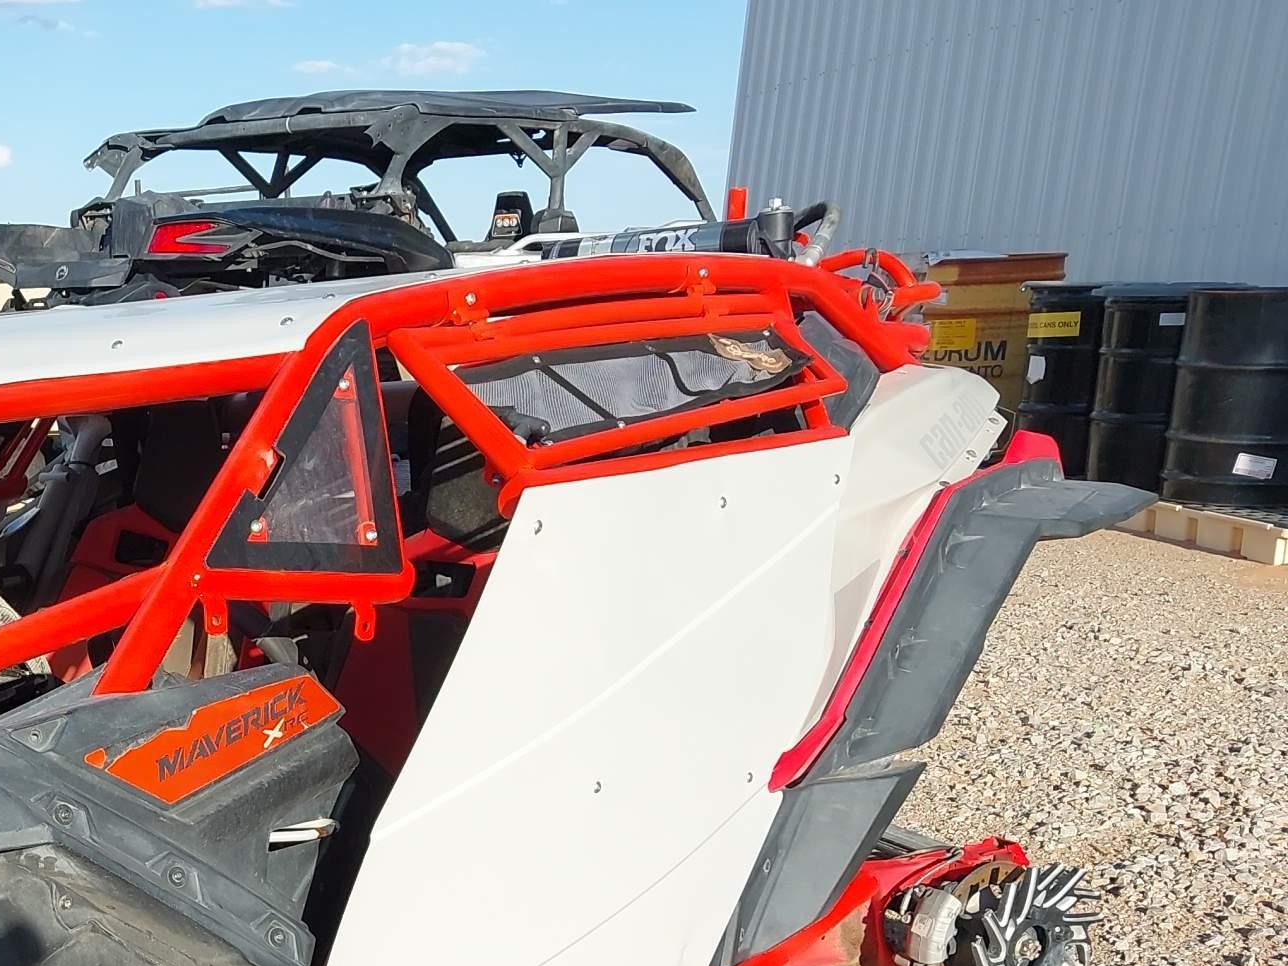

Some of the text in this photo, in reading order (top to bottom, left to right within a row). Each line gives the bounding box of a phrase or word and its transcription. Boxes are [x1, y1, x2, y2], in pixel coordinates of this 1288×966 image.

[637, 228, 699, 253] FOX
[1057, 320, 1079, 328] ONLY
[934, 340, 1007, 361] DRUM
[156, 680, 306, 782] MAVERICK
